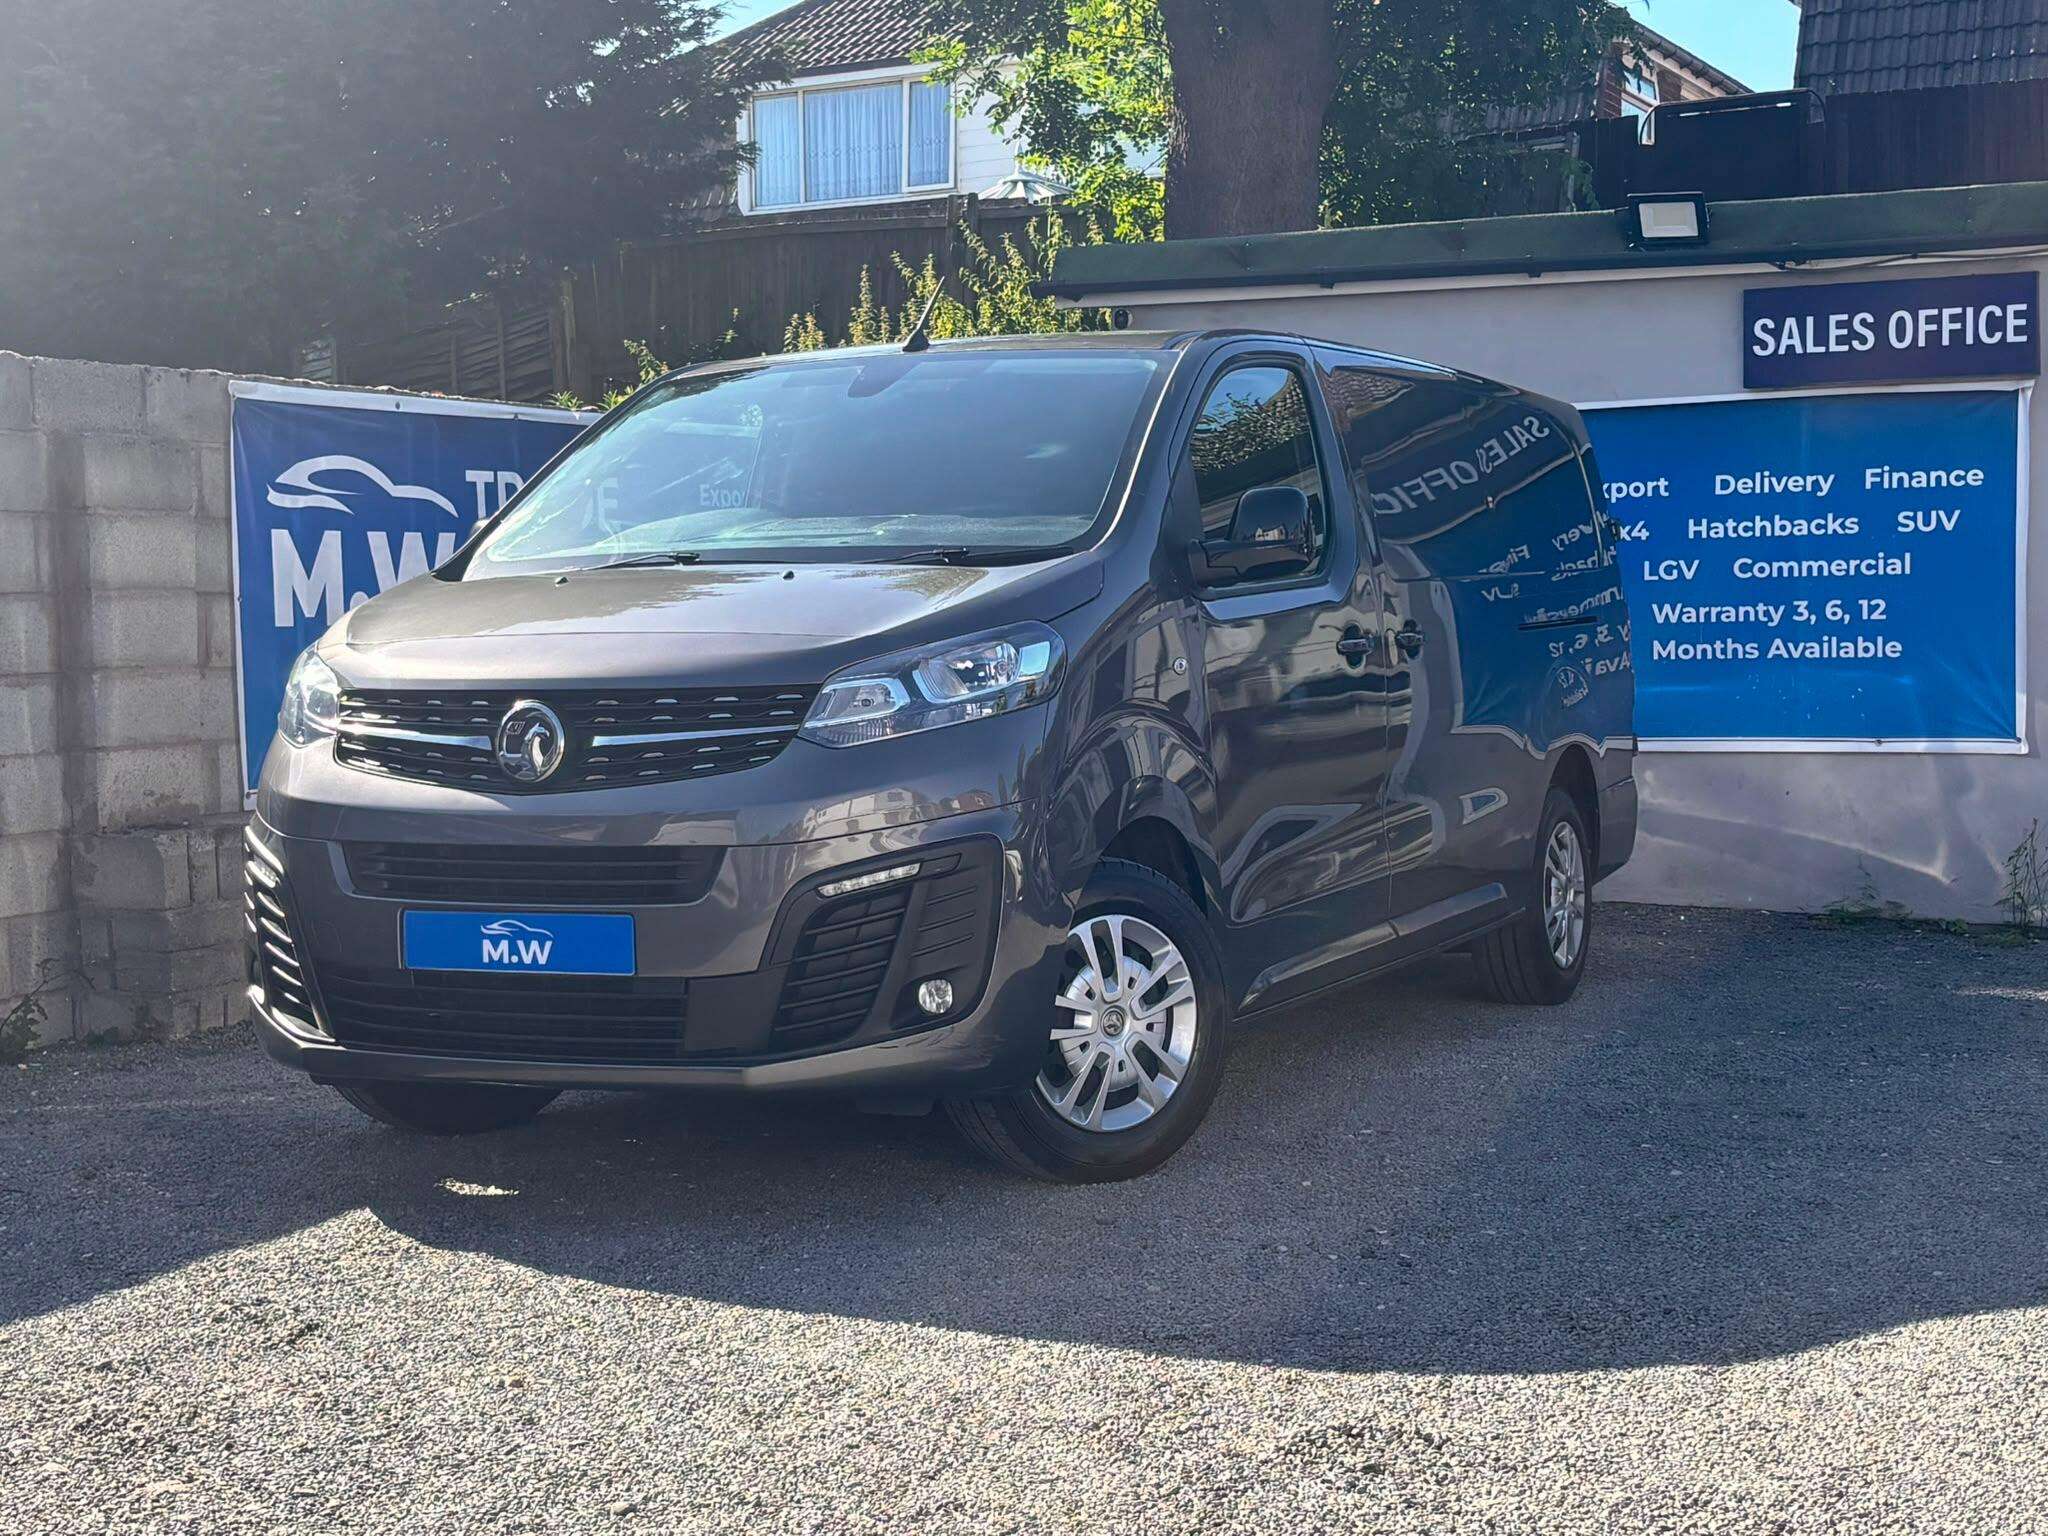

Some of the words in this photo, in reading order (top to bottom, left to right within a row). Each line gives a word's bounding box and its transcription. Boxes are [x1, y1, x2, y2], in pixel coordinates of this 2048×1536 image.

[1752, 312, 1875, 356] SALES
[1888, 303, 2028, 349] OFFICE
[1602, 477, 1669, 504] xport
[1715, 470, 1835, 500] Delivery
[1865, 465, 1984, 490] Finance
[1619, 520, 1650, 541] x4
[1688, 513, 1860, 539] Hatchbacks
[1897, 509, 1961, 532] SUV
[271, 528, 456, 627] M.W
[1644, 559, 1700, 581] LGV
[1733, 552, 1911, 579] Commercial
[1652, 602, 1785, 627] Warranty
[1792, 600, 1817, 625] 3,
[1825, 599, 1850, 624] 6,
[1858, 599, 1887, 620] 12
[1653, 638, 1759, 660] Months
[1767, 635, 1902, 659] Available
[482, 939, 553, 965] M.W
